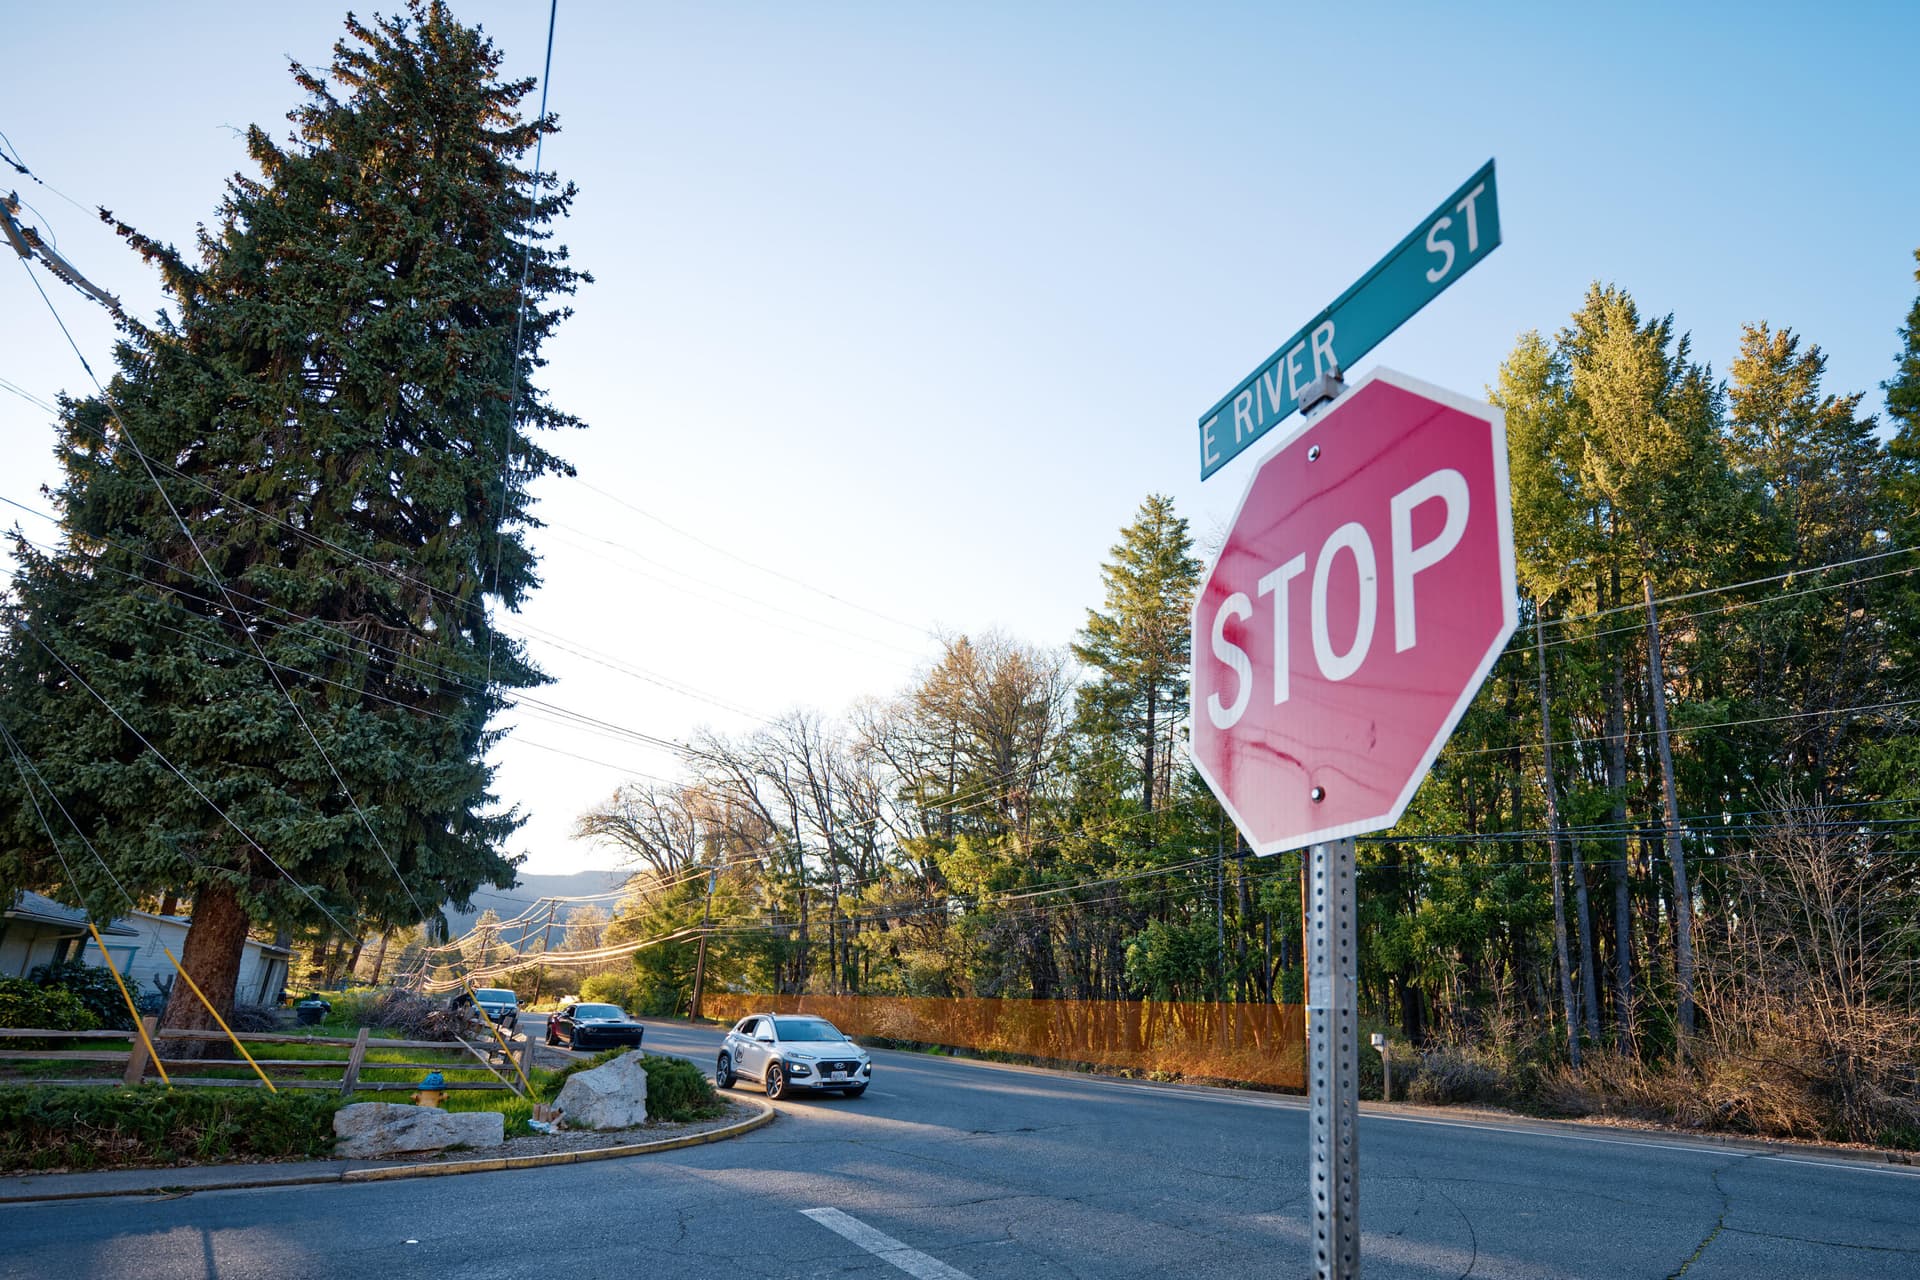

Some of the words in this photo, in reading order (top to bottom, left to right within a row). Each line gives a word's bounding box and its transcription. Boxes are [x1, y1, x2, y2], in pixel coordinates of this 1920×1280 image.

[1203, 415, 1220, 468] E
[1233, 319, 1338, 444] RIVER
[1425, 182, 1486, 284] ST
[1207, 468, 1470, 730] STOP
